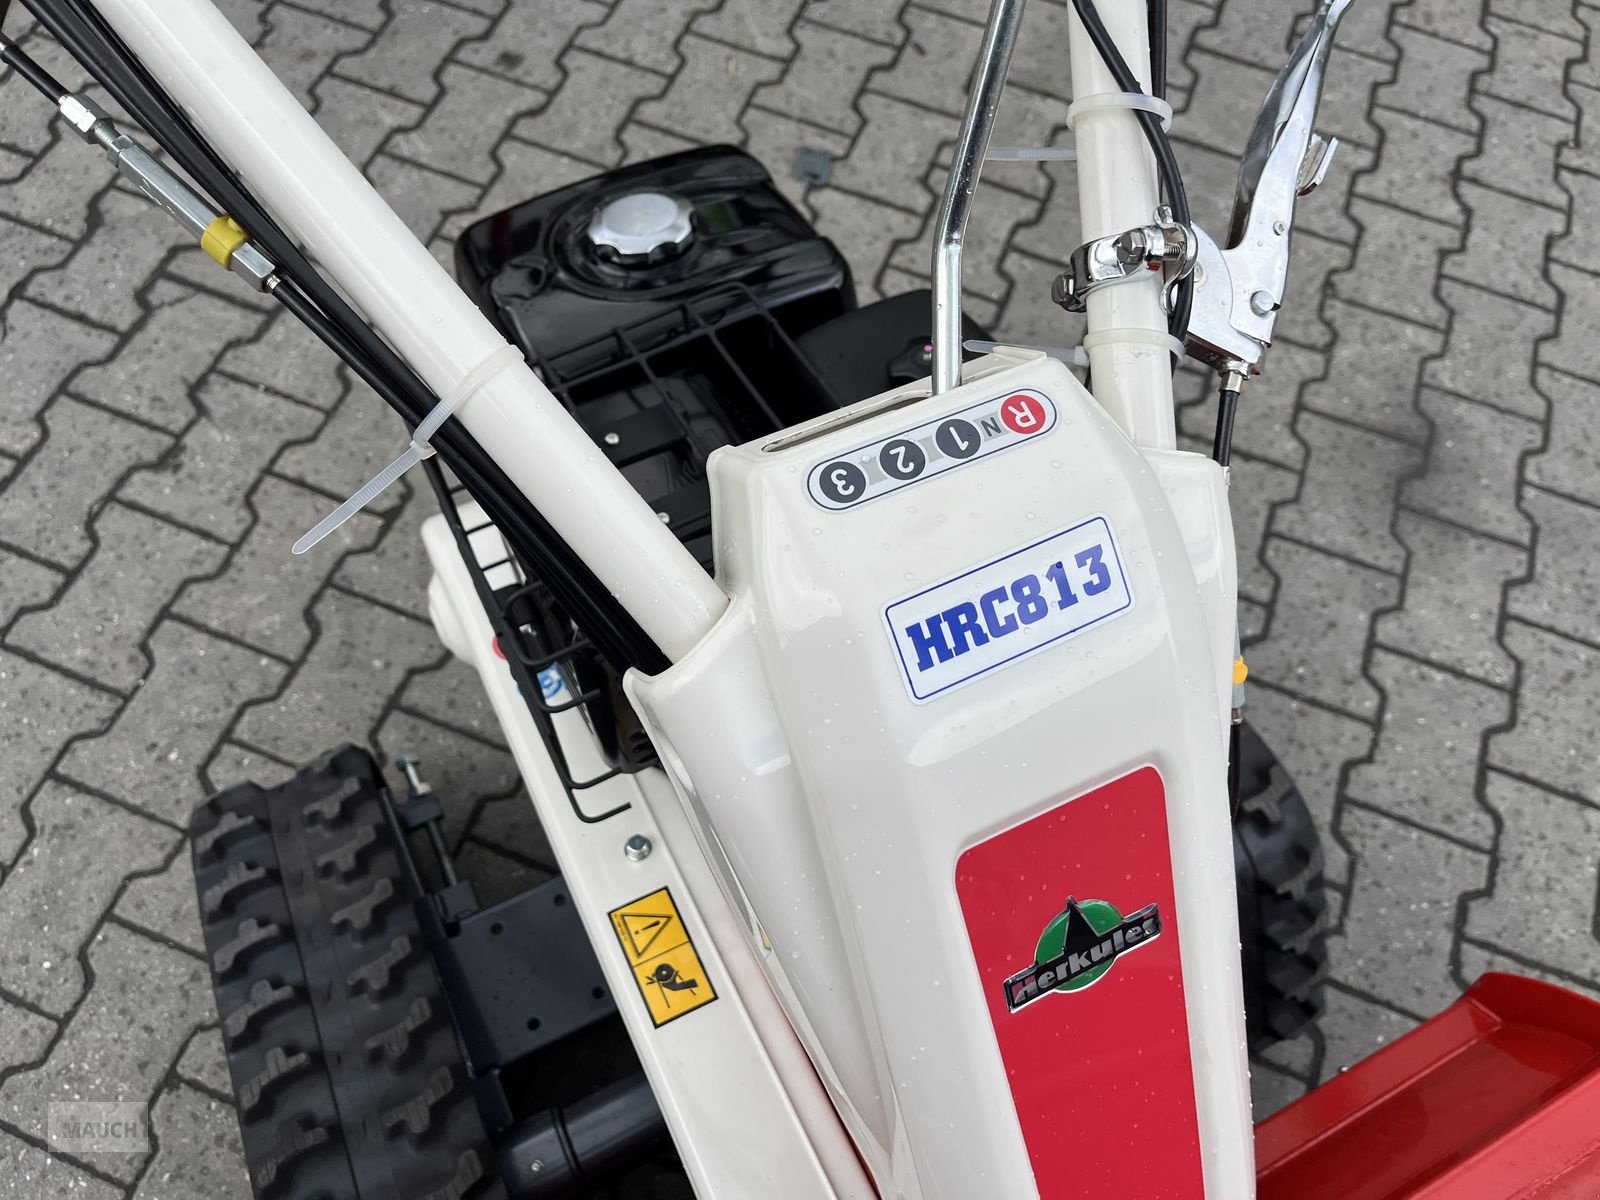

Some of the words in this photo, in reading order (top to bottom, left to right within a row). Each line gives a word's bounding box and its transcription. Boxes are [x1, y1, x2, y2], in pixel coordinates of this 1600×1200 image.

[982, 416, 1002, 438] N
[1007, 400, 1037, 428] R
[949, 426, 969, 451] 1
[889, 446, 915, 472] 2
[830, 468, 855, 496] 3
[905, 544, 1112, 672] HRC813
[1011, 918, 1160, 1004] Herkules
